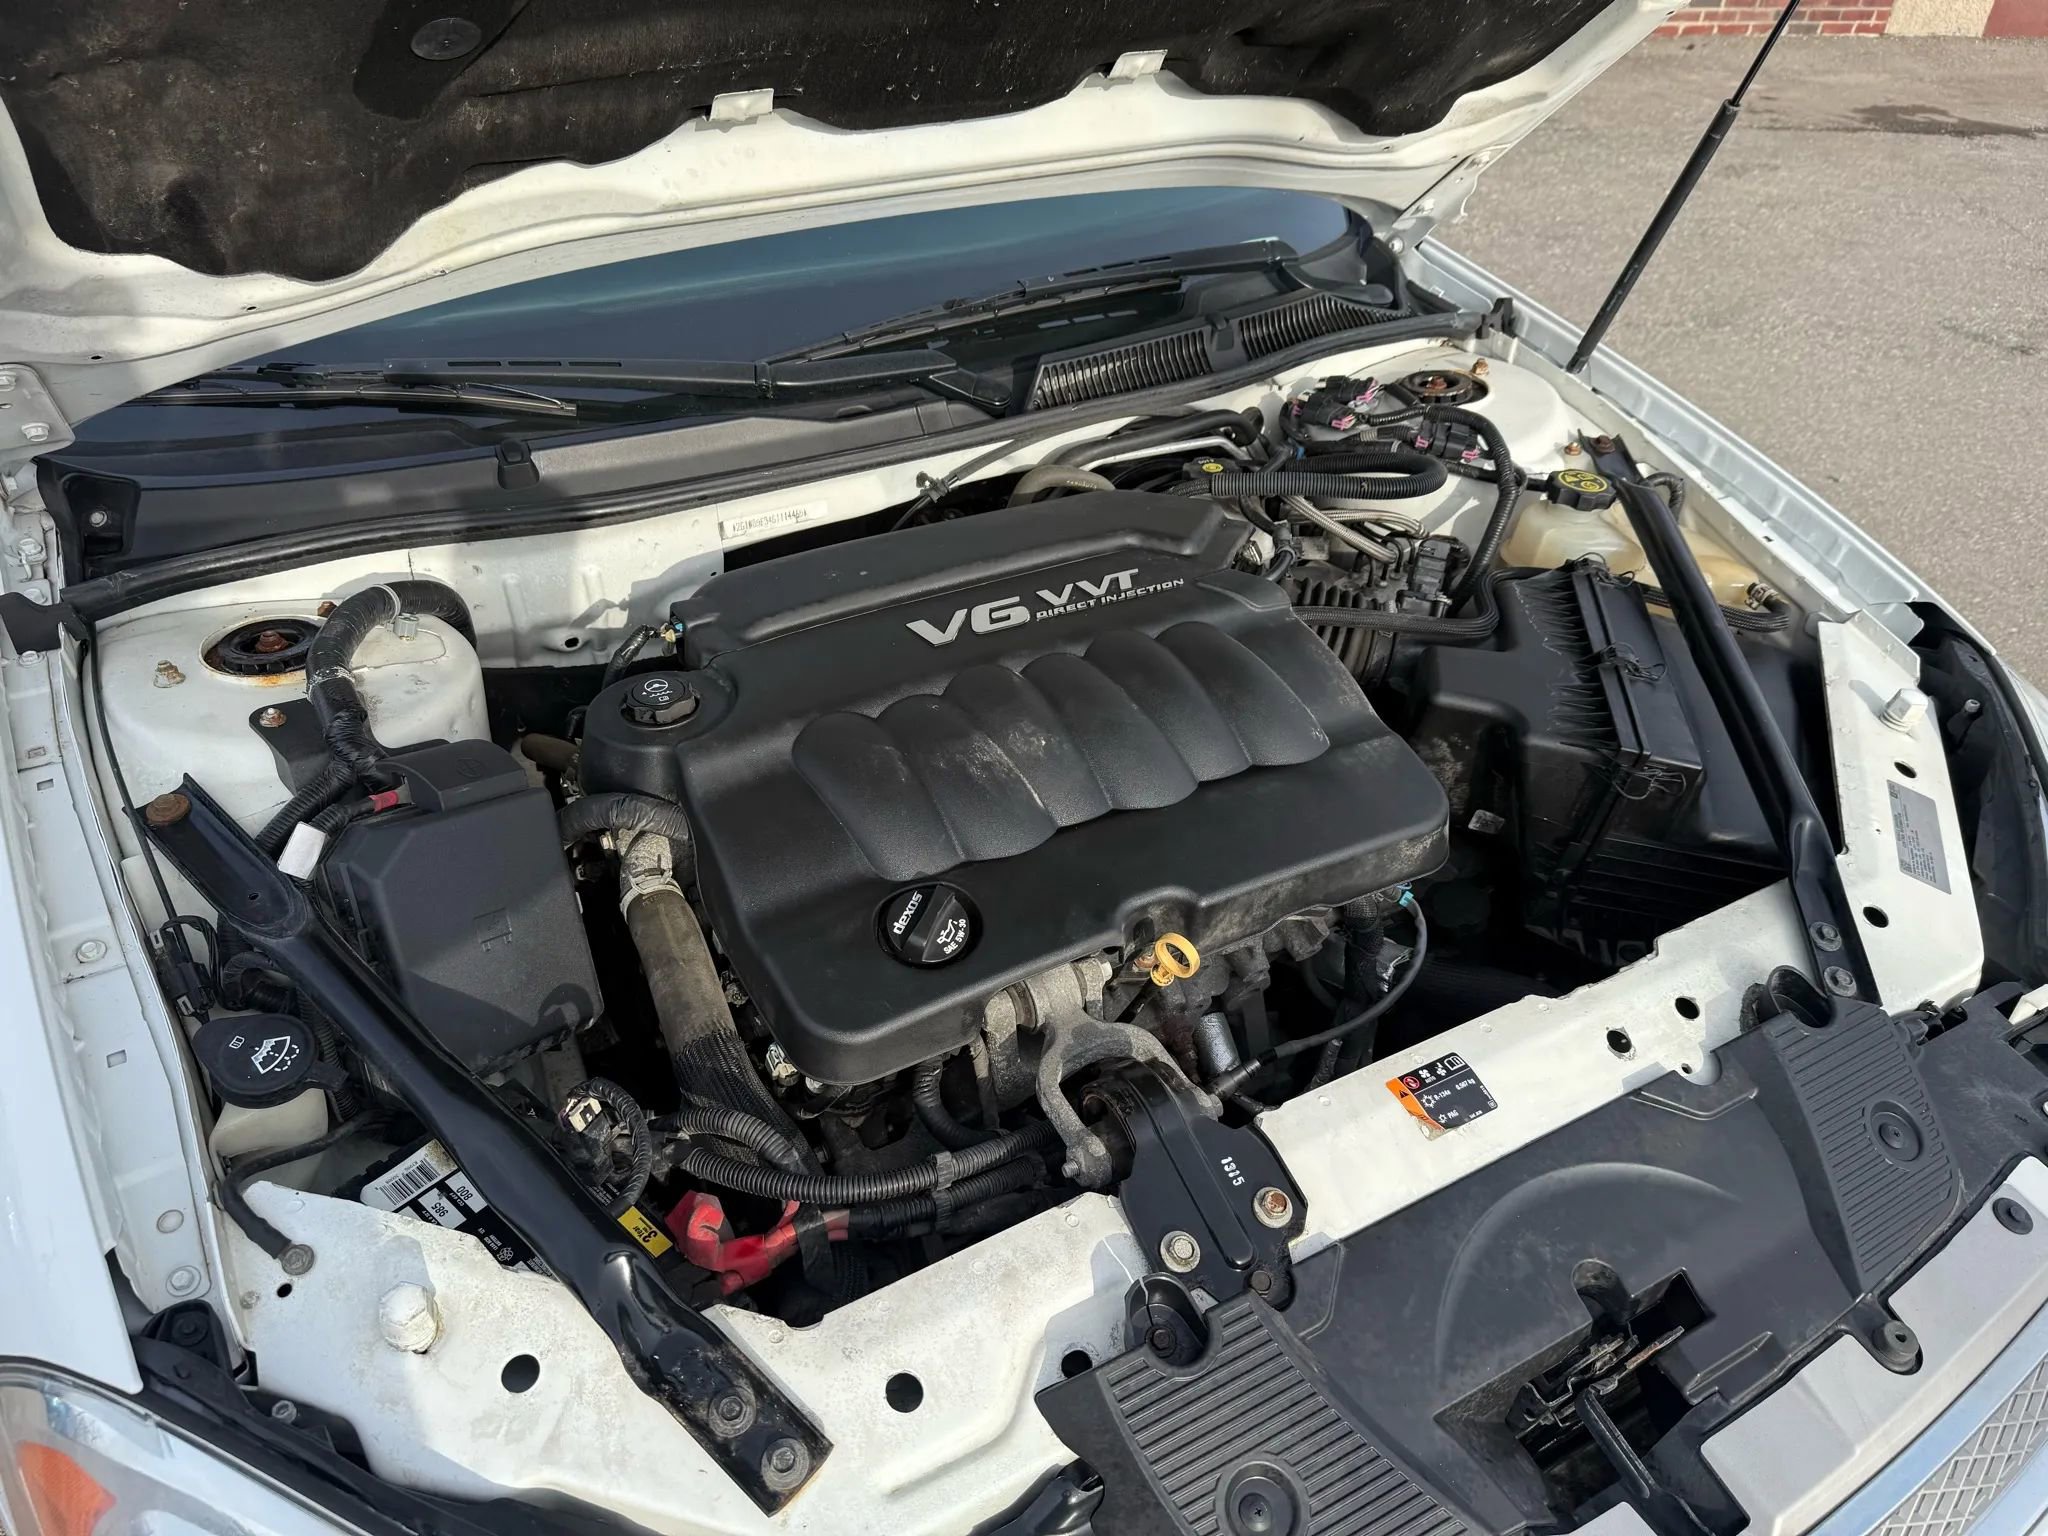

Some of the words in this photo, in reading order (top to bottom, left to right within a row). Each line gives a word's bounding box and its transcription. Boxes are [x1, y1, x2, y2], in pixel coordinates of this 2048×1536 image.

[905, 596, 1031, 647] V6
[1036, 568, 1139, 606] VVT
[1036, 598, 1097, 622] DIRECT
[1101, 578, 1184, 606] INJECTION
[892, 890, 924, 935] dexos
[943, 942, 958, 955] SAE
[955, 918, 967, 943] 5W-30
[1447, 1109, 1459, 1119] PAG
[1221, 1156, 1246, 1187] 1315
[456, 1185, 474, 1201] 800
[431, 1201, 449, 1218] 985
[632, 1226, 645, 1239] Year
[642, 1230, 658, 1243] 3
